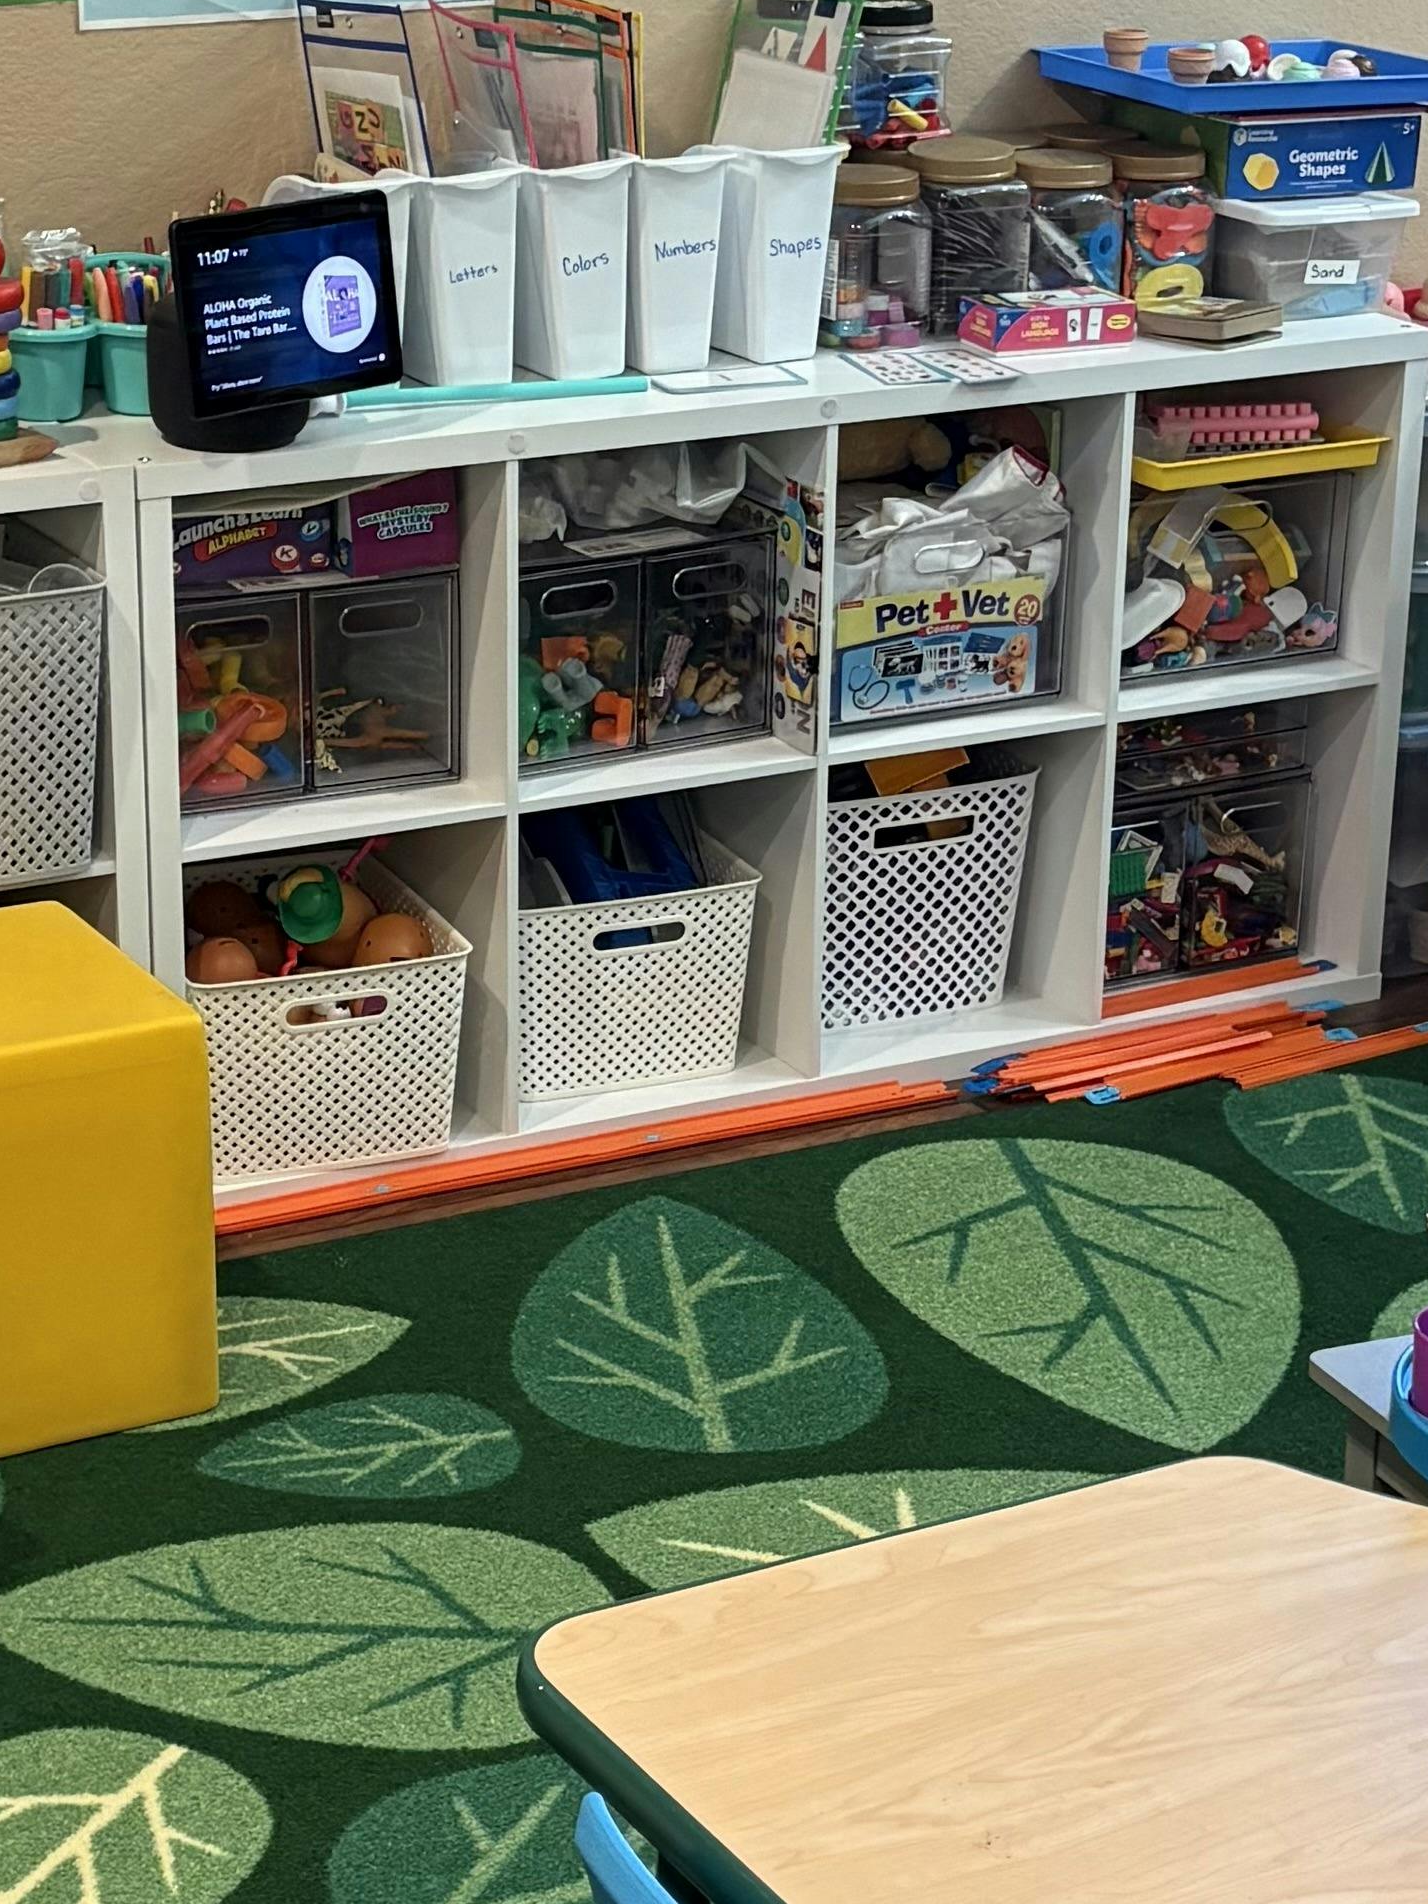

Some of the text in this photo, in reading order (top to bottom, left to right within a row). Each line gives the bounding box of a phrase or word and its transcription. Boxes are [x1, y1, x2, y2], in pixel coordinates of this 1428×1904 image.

[1289, 147, 1358, 162] Geometric
[1299, 163, 1345, 178] Shapes
[197, 248, 229, 265] 11:07
[655, 238, 716, 261] Numbers
[770, 236, 821, 258] Shapes
[449, 264, 497, 283] Letters
[562, 252, 608, 276] Colors
[1311, 265, 1344, 277] Sand
[203, 294, 271, 314] ALOHA Organic
[258, 307, 290, 321] Protein
[876, 589, 1009, 632] Pet Vet
